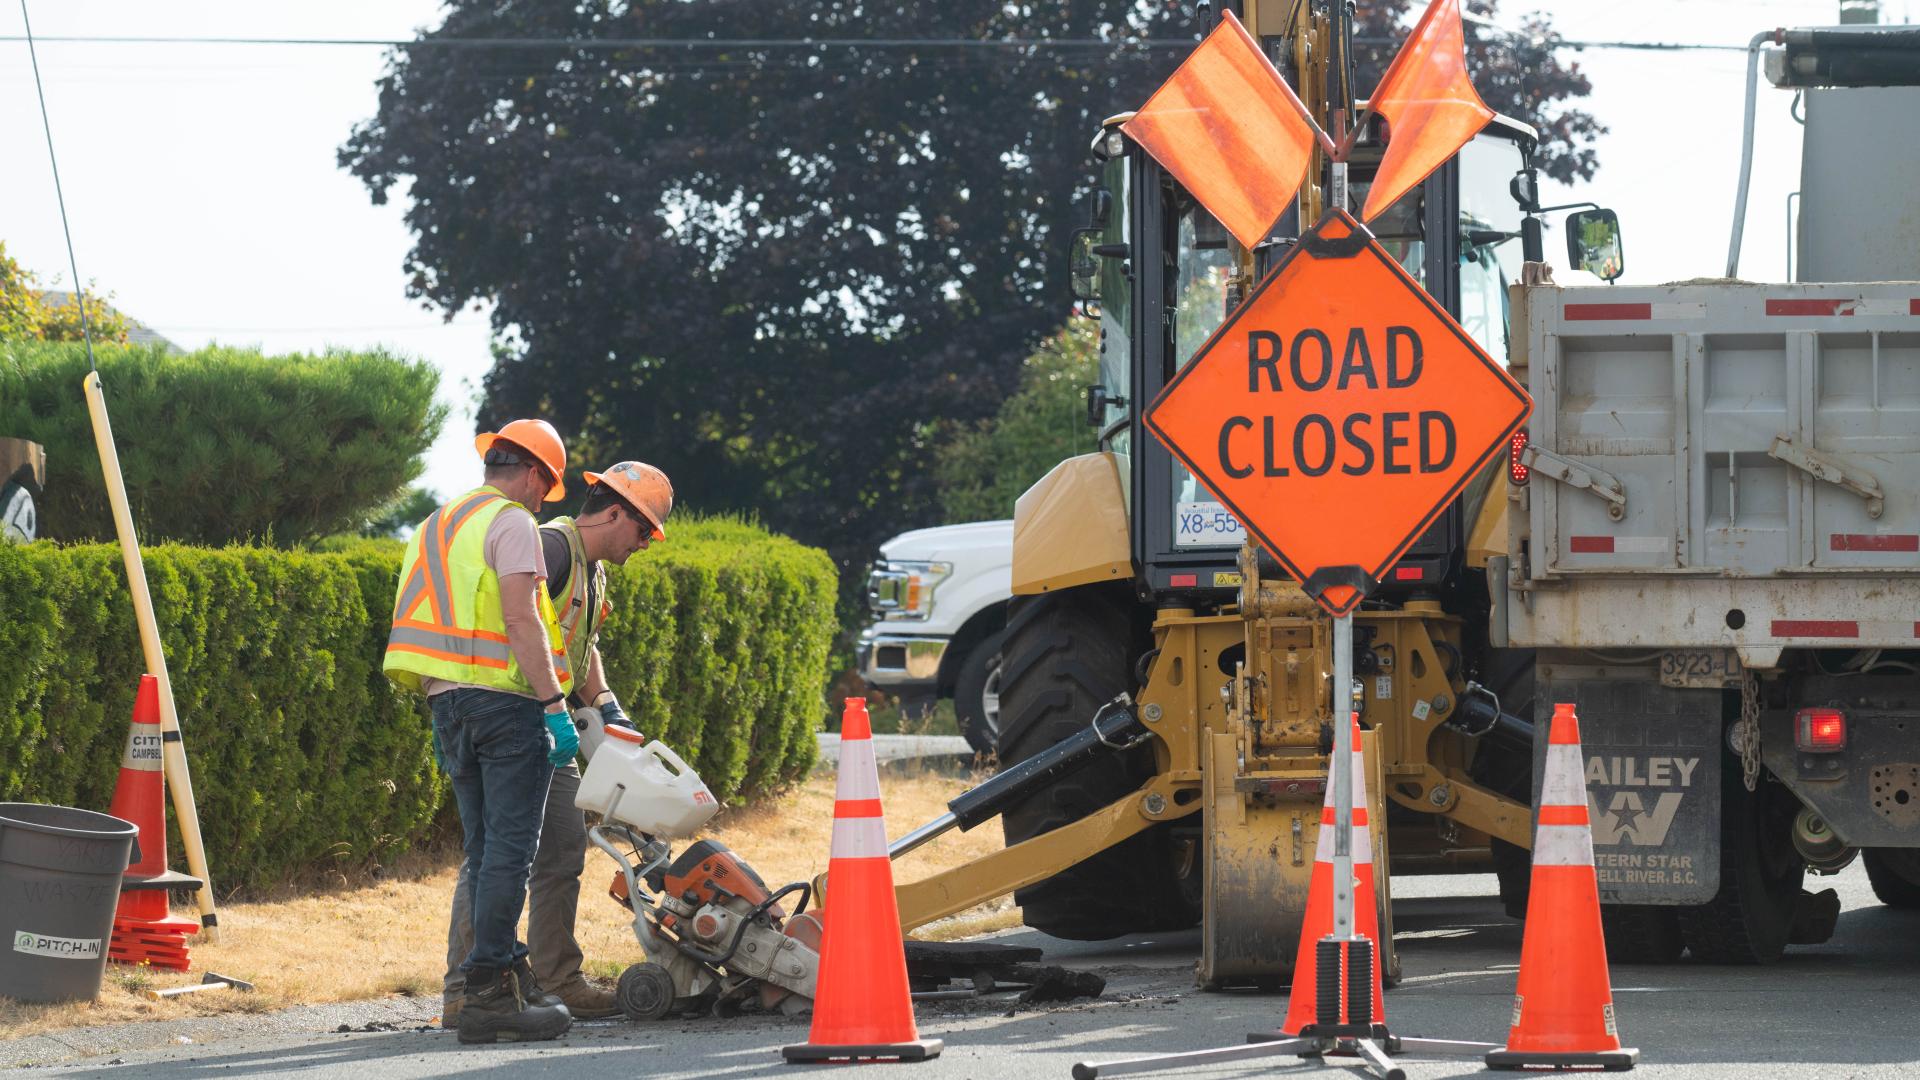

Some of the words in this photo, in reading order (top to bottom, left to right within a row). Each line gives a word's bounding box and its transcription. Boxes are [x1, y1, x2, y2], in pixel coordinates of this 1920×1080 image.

[1247, 325, 1424, 393] ROAD
[1218, 410, 1457, 480] CLOSED
[1180, 513, 1204, 534] X8
[1214, 512, 1244, 533] 55
[1663, 653, 1712, 676] 3923
[133, 736, 162, 746] CITY
[132, 748, 163, 760] CAMPBEL
[1584, 756, 1700, 787] AILEY
[1596, 853, 1642, 868] TERN
[1646, 855, 1692, 868] STAR
[1626, 870, 1670, 884] RIVER,
[1672, 871, 1698, 885] B.C.
[36, 938, 100, 955] PITCH-IN
